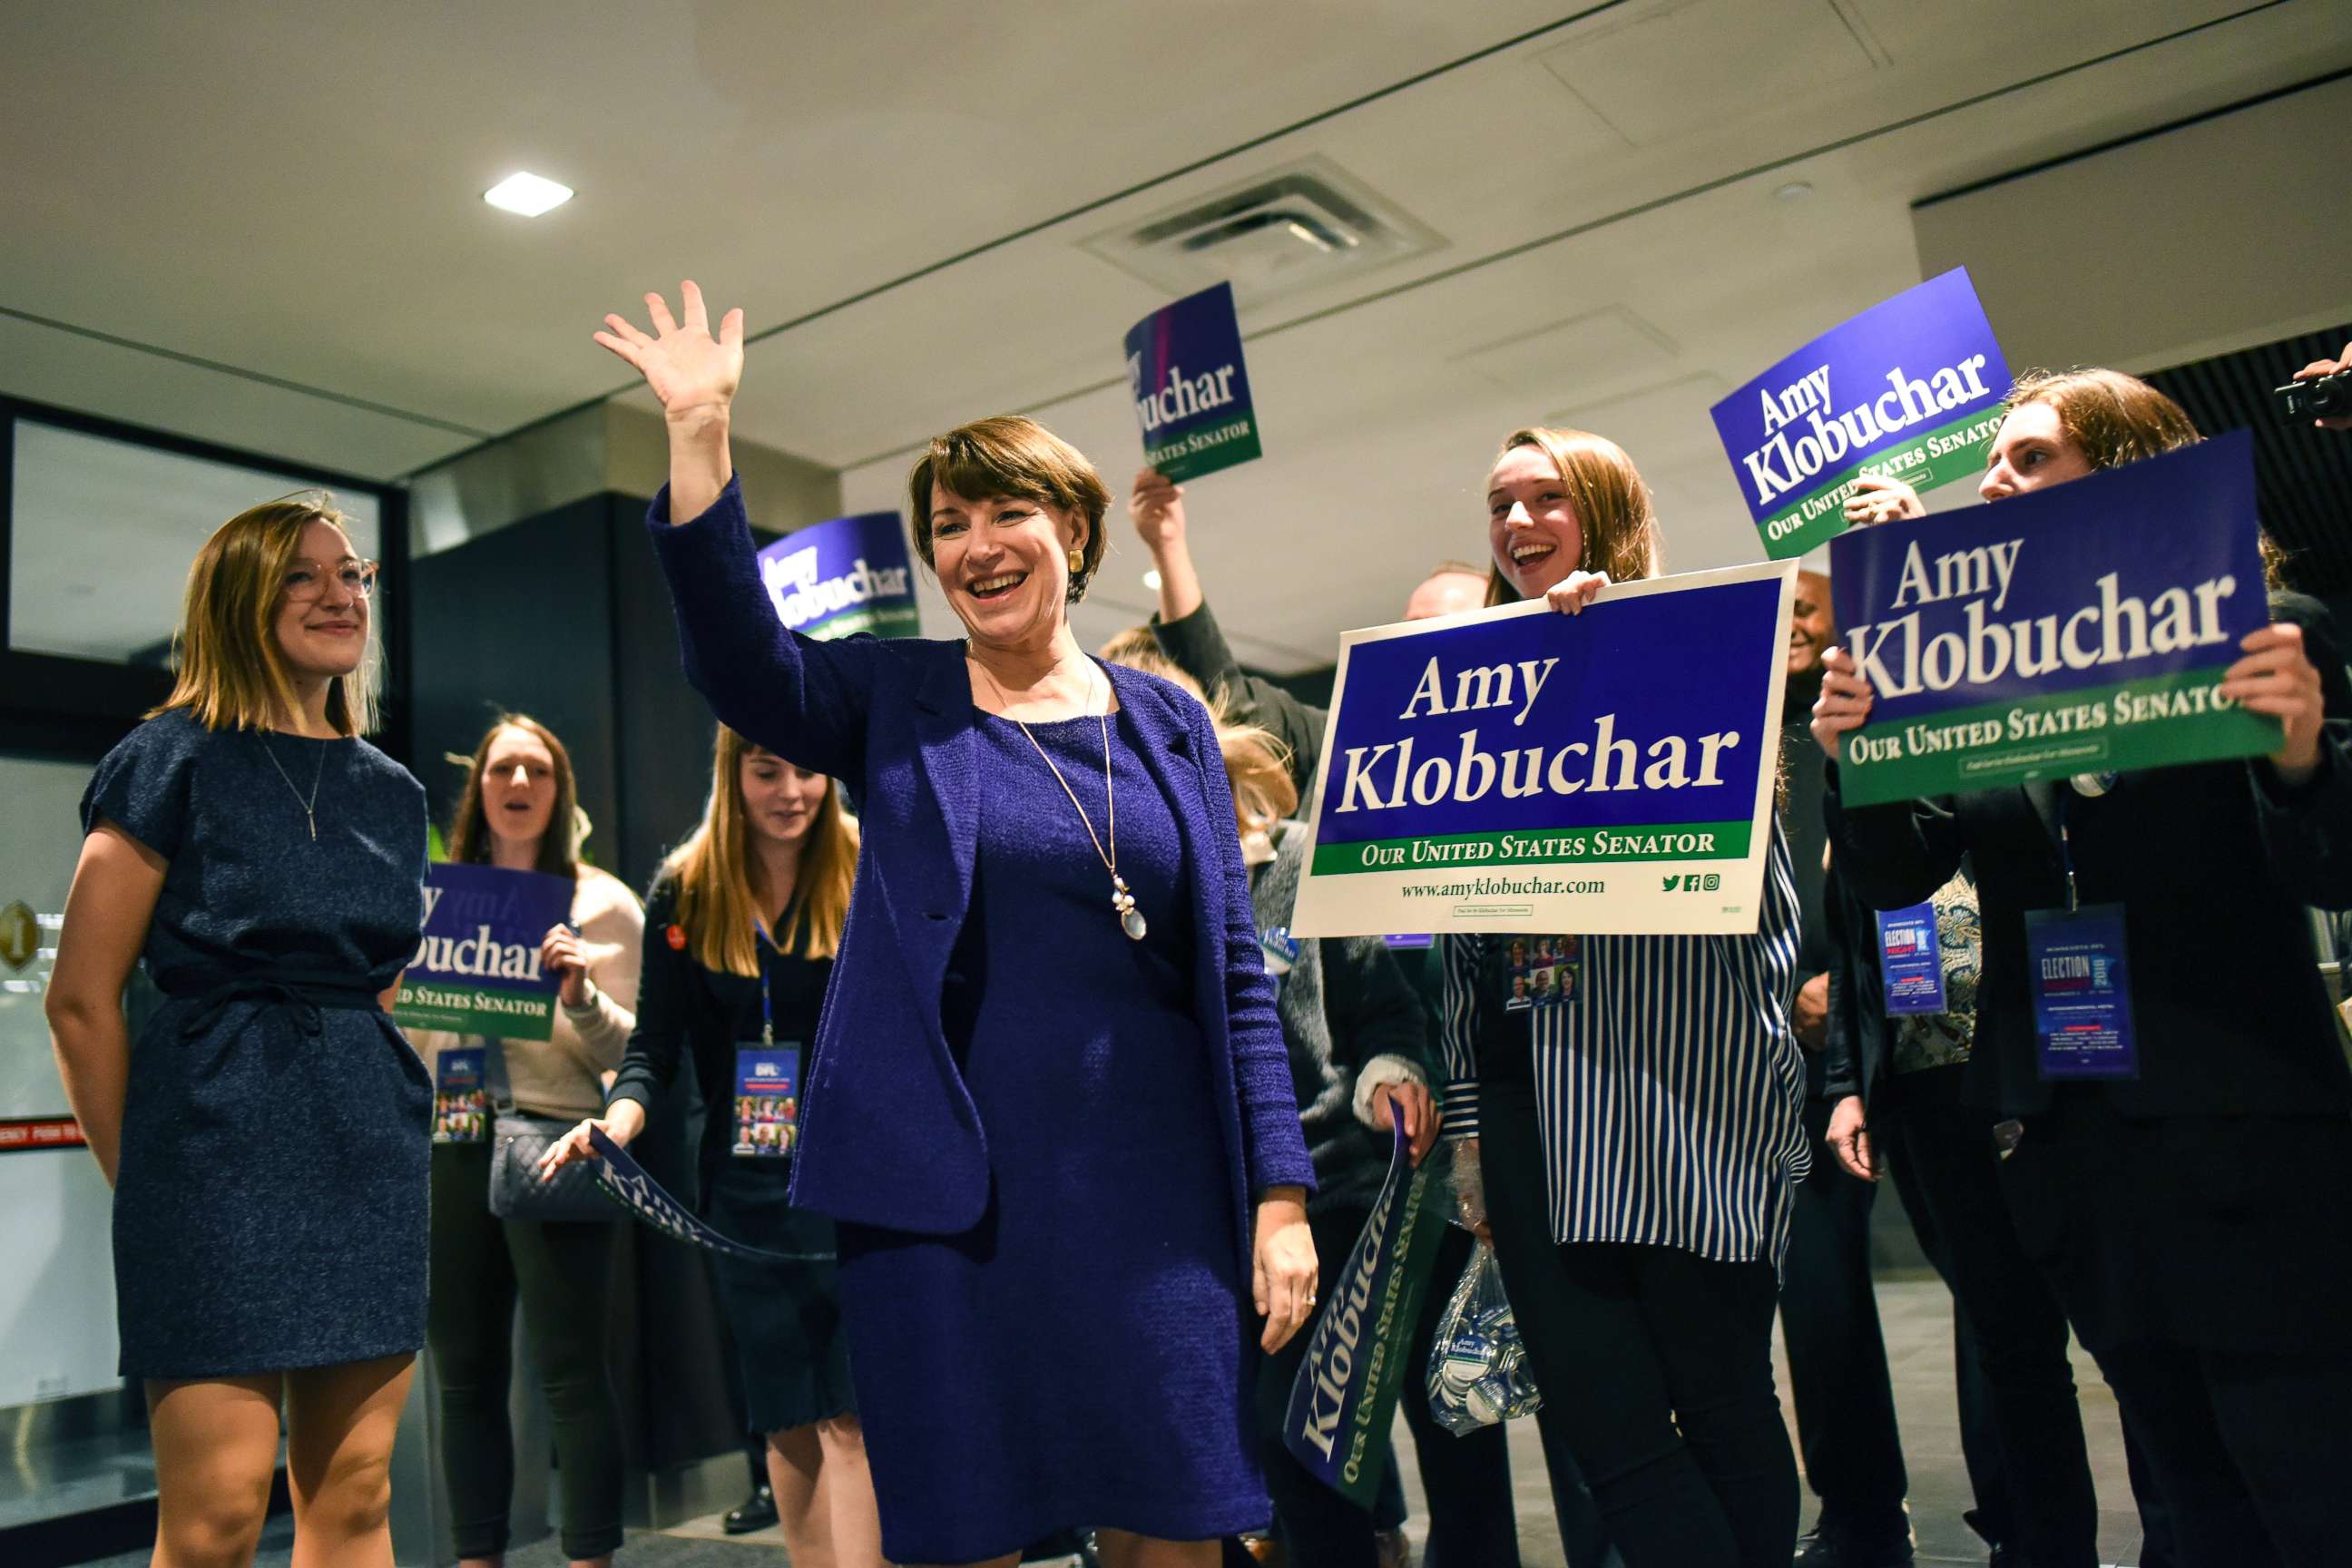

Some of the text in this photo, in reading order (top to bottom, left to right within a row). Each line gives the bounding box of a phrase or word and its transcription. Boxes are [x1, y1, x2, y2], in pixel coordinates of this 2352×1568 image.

[1187, 420, 1250, 452] SENATOR
[1743, 353, 1990, 505] Klobuchar
[1759, 364, 1831, 436] Amy
[1767, 515, 1804, 541] OUR
[1800, 479, 1860, 520] UNITED
[1926, 417, 2003, 460] SENATO
[1890, 538, 2024, 612] Amy
[1846, 572, 2237, 700] Klobuchar
[1399, 656, 1560, 726] Amy
[1849, 682, 2235, 765] OUR UNITED STATES SENATO
[1335, 713, 1740, 813] Klobuchar
[1362, 830, 1716, 867] OUR UNITED STATES SENATOR
[1402, 877, 1605, 900] www.amyklobuchar.com
[416, 985, 471, 1010] STATES
[475, 991, 547, 1017] SENATOR
[2042, 956, 2091, 980] ELECTION
